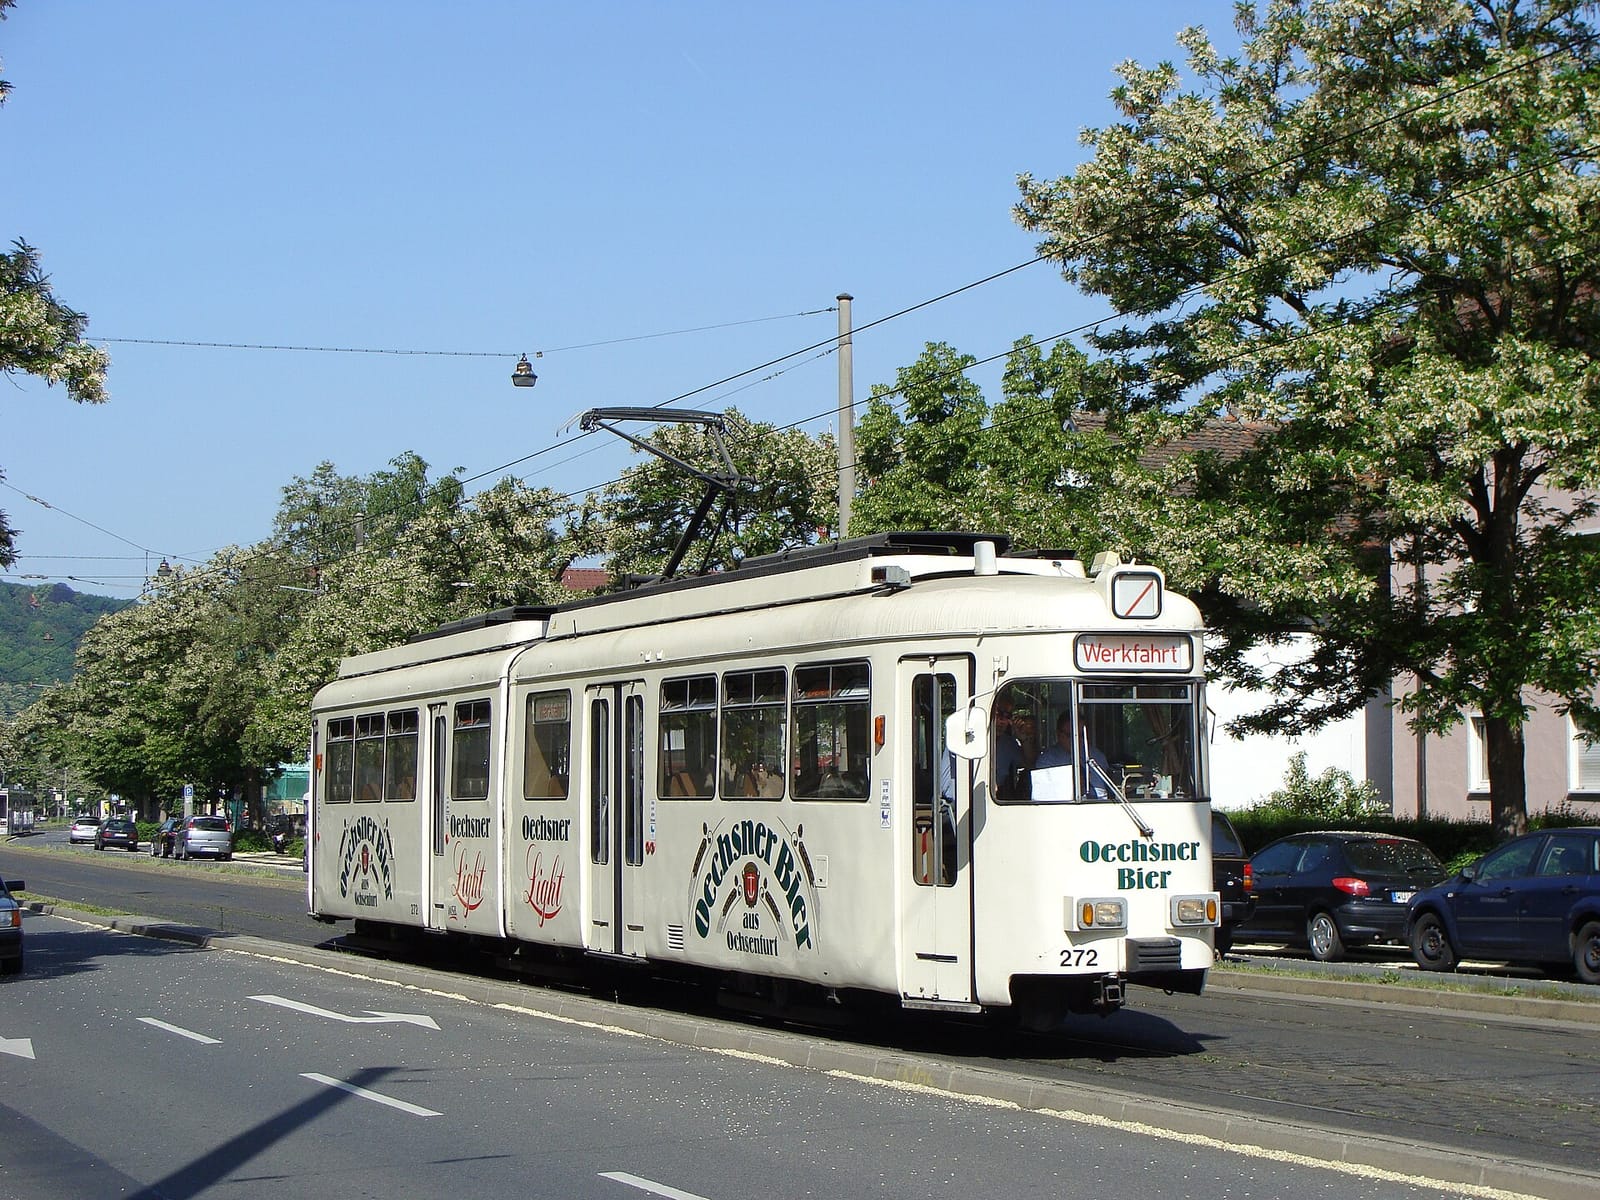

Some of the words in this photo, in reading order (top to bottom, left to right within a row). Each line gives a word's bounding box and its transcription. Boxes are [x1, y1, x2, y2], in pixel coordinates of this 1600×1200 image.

[1083, 643, 1177, 663] Werkfahrt
[450, 814, 491, 838] Oechsner
[522, 815, 571, 841] Oechsner
[1080, 839, 1200, 863] Oechsner
[452, 841, 487, 919] Light
[524, 844, 566, 929] Light
[695, 819, 777, 939] Oechsner
[774, 838, 812, 950] Bier
[1117, 868, 1171, 890] Bier
[743, 912, 760, 930] aus
[727, 931, 778, 957] Ochsenfurt
[1060, 949, 1098, 967] 272
